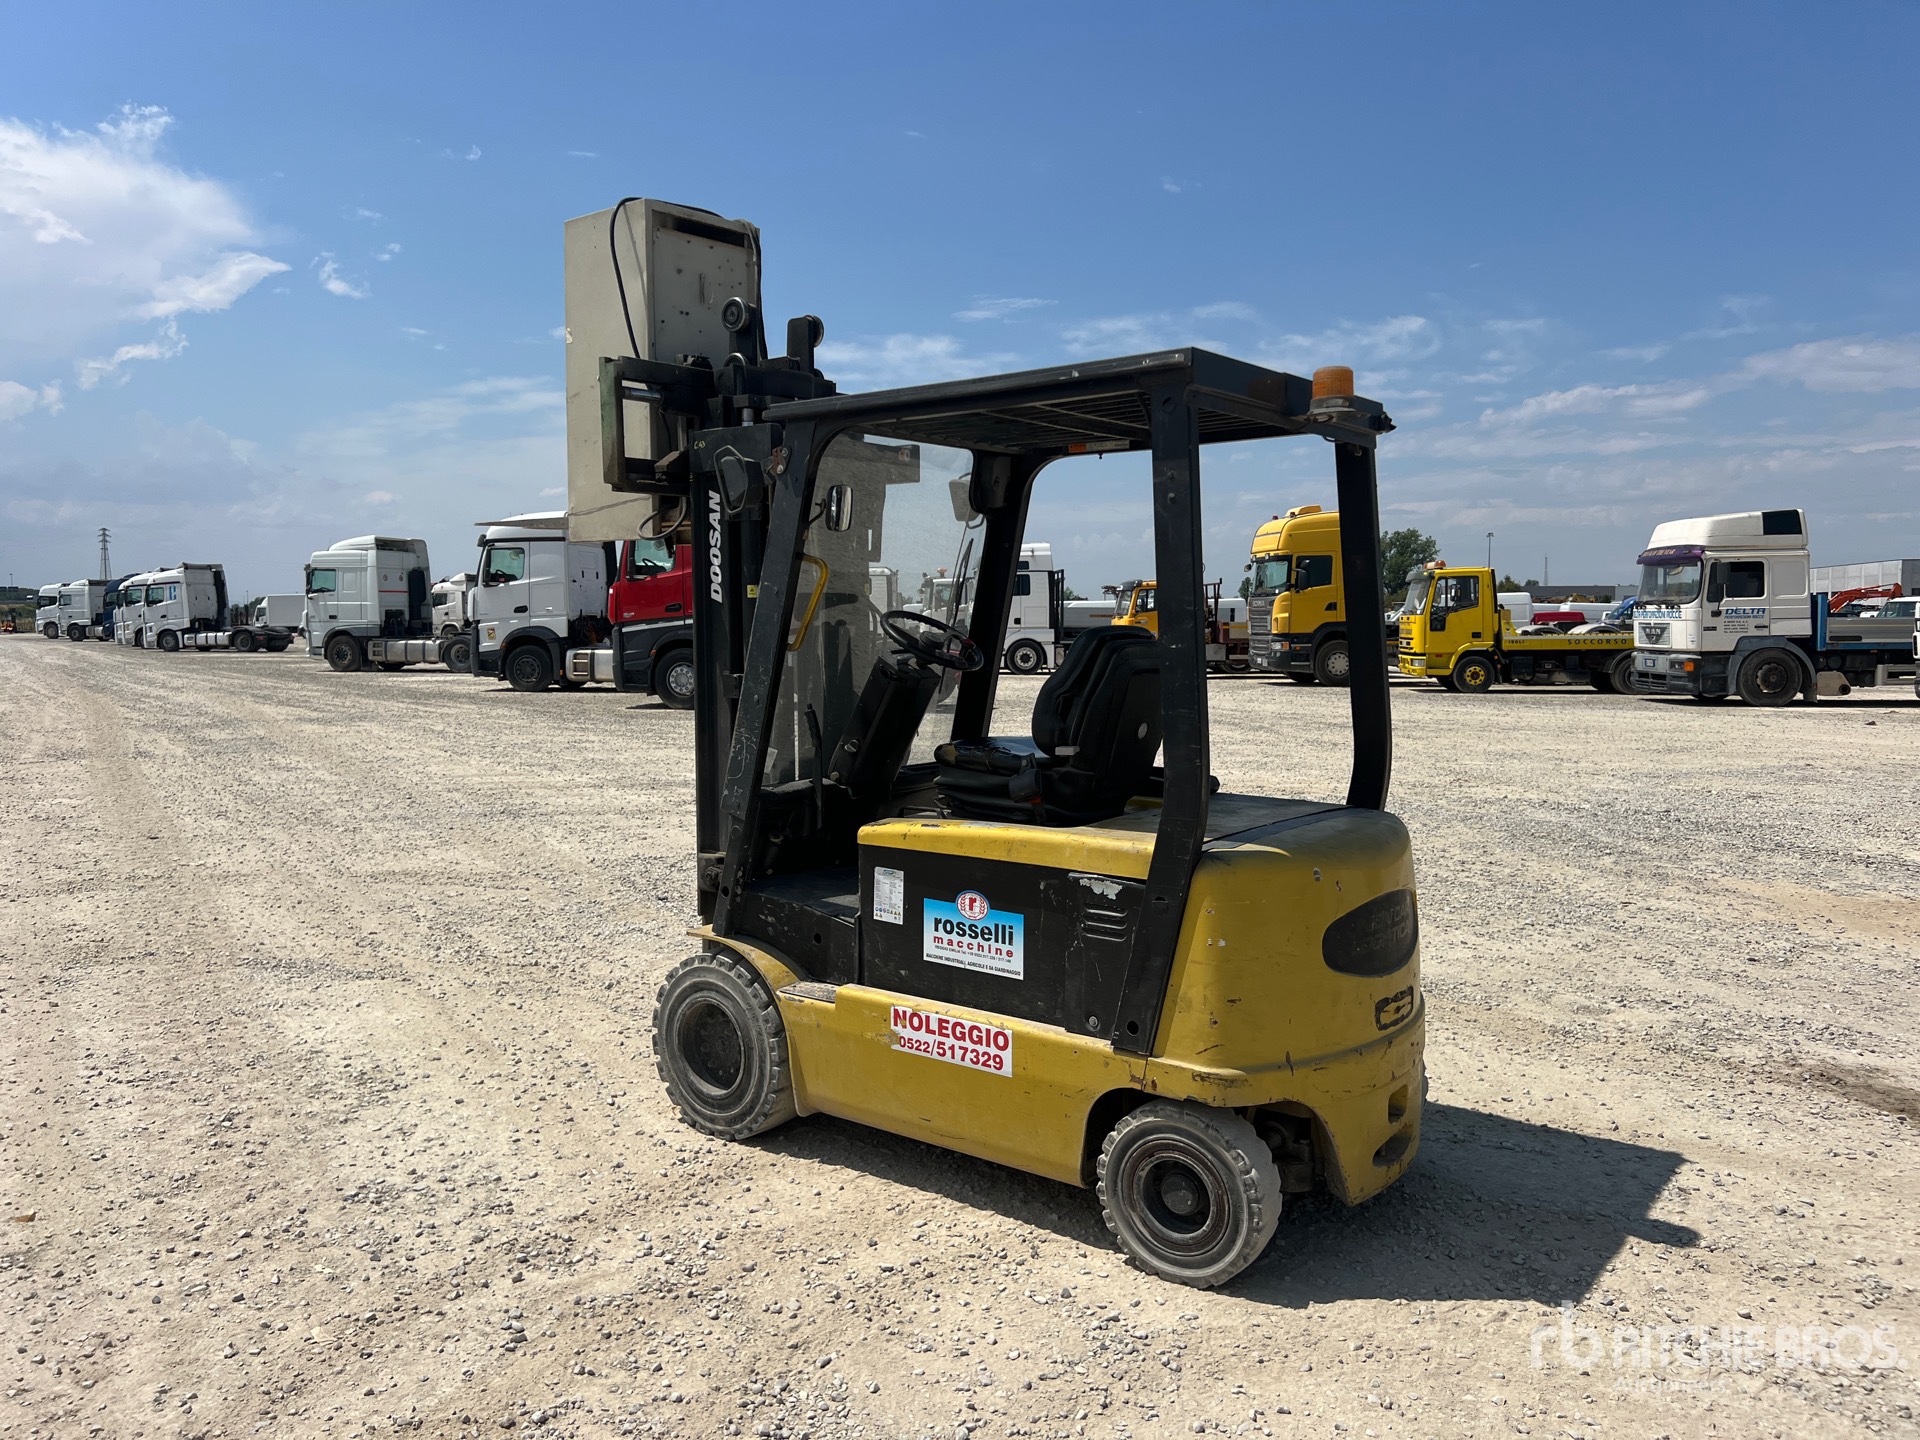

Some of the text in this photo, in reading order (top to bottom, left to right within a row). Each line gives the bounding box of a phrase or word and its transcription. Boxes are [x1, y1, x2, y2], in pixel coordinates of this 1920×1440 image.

[708, 489, 723, 603] DOOSAN
[1725, 607, 1766, 615] DELTA
[933, 917, 1014, 946] rosselli
[933, 935, 1014, 958] macchine
[925, 953, 944, 961] MACCHINE
[967, 961, 985, 969] AGRICOLE
[994, 966, 1021, 976] GIARDINAGGIO
[893, 1008, 1010, 1052] NOLEGGIO
[899, 1036, 1004, 1071] 0522/517329
